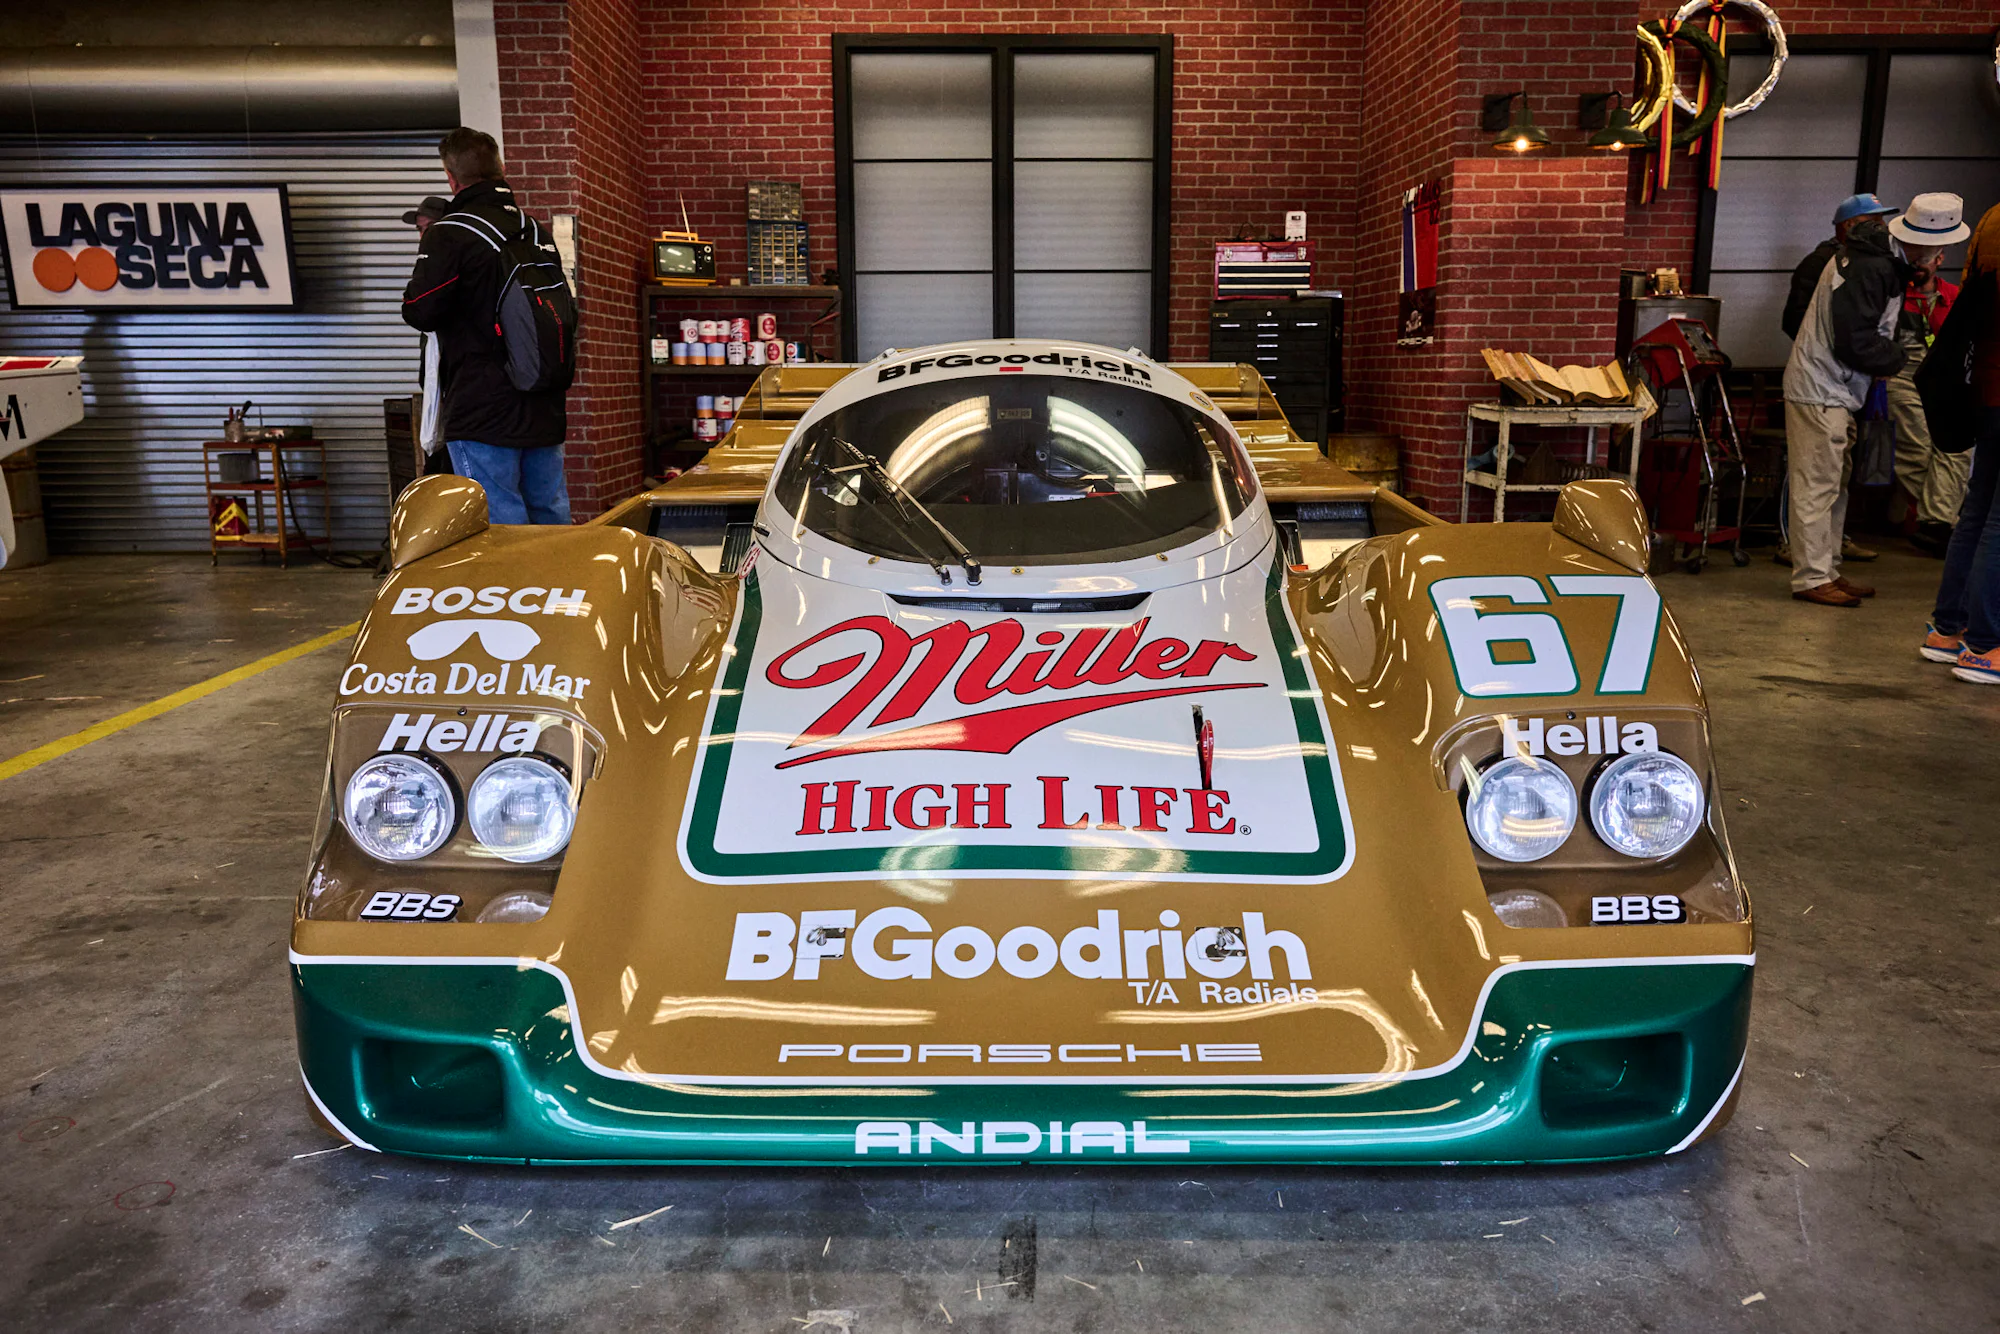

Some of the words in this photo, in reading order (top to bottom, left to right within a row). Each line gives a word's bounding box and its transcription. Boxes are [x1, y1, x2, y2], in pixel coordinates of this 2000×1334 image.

[25, 202, 264, 248] LAGUNA
[116, 245, 269, 289] SECA
[877, 352, 1151, 384] BFGoodrich
[1065, 367, 1091, 376] T/A
[1098, 371, 1152, 388] Radials
[390, 586, 588, 617] BOSCH
[1428, 573, 1663, 699] 67
[339, 663, 437, 696] Costa
[443, 662, 510, 695] Del
[516, 664, 591, 699] Mar
[765, 615, 1258, 750] Miller
[377, 713, 542, 752] Hella
[1503, 716, 1659, 757] Hella
[796, 780, 1012, 836] HIGH
[1037, 776, 1236, 834] LIFE
[360, 891, 464, 921] BBS
[1591, 894, 1687, 923] BBS
[725, 906, 1313, 981] BFGoodrich
[1128, 981, 1179, 1005] T/A
[1201, 981, 1318, 1005] Radials
[778, 1044, 1263, 1063] PORSCHE
[854, 1121, 1190, 1154] ANDIAL
